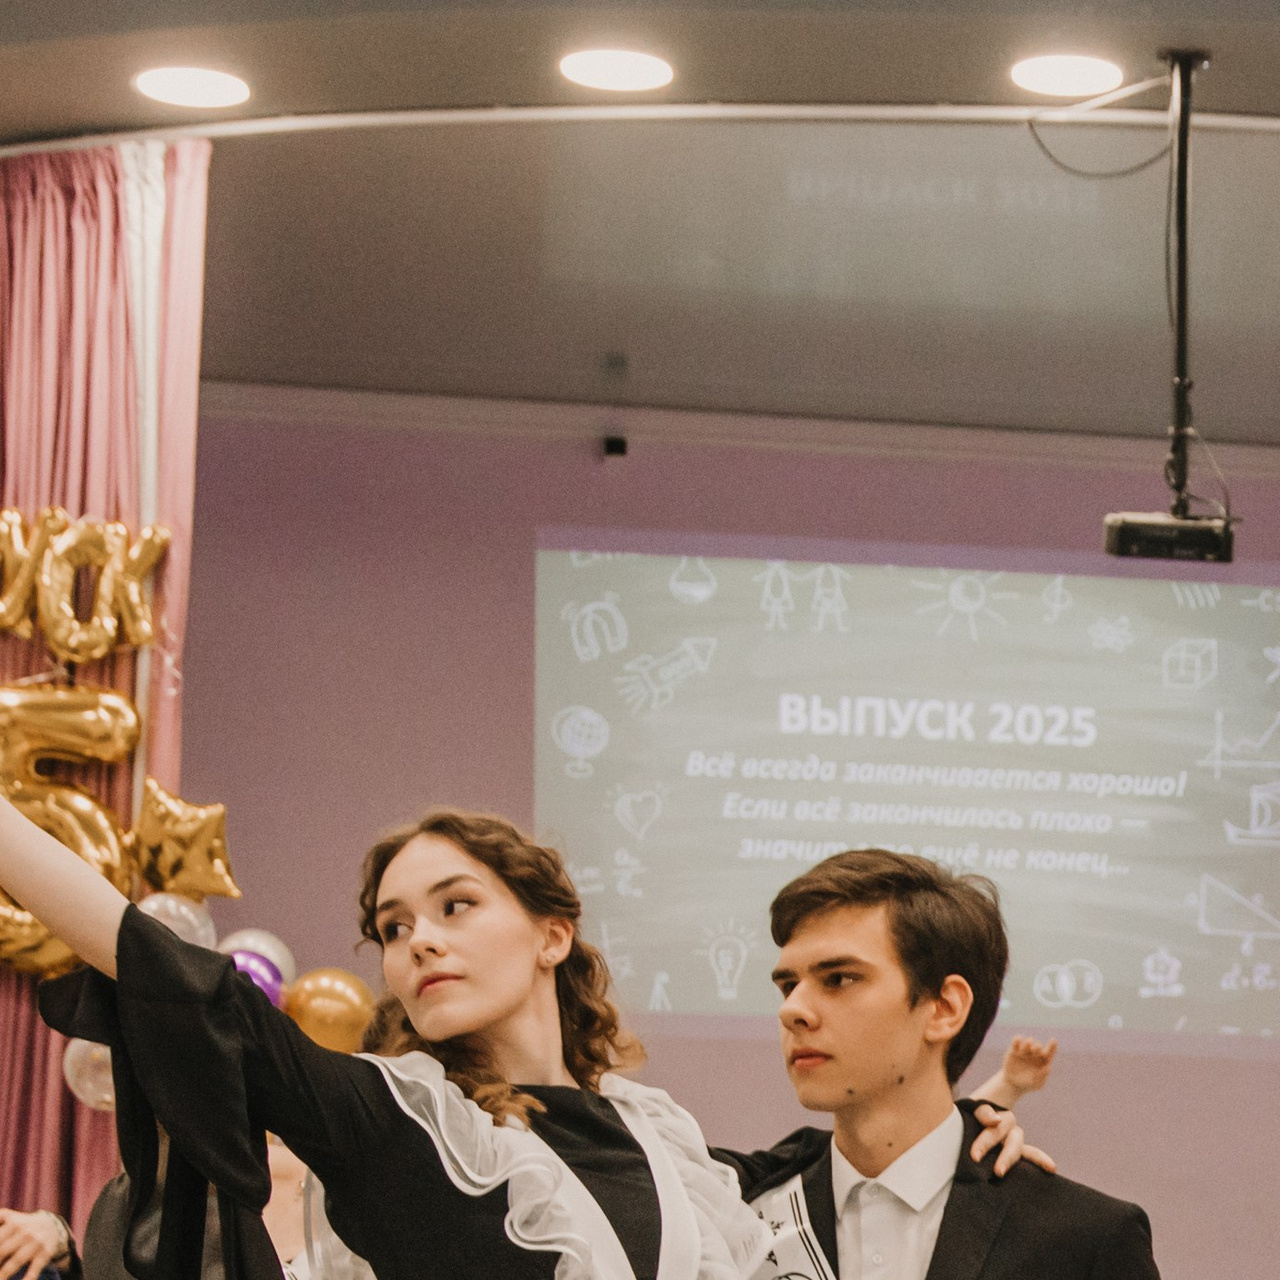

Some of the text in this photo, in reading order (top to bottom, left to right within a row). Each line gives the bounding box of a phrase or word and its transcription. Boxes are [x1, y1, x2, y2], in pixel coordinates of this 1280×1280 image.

[778, 693, 1099, 748] ВЫПУСК 2025
[685, 750, 1189, 798] Всё всегда заканчивается хорошо!
[722, 792, 788, 821] Если
[1029, 809, 1114, 834] плохо
[985, 848, 1021, 872] не
